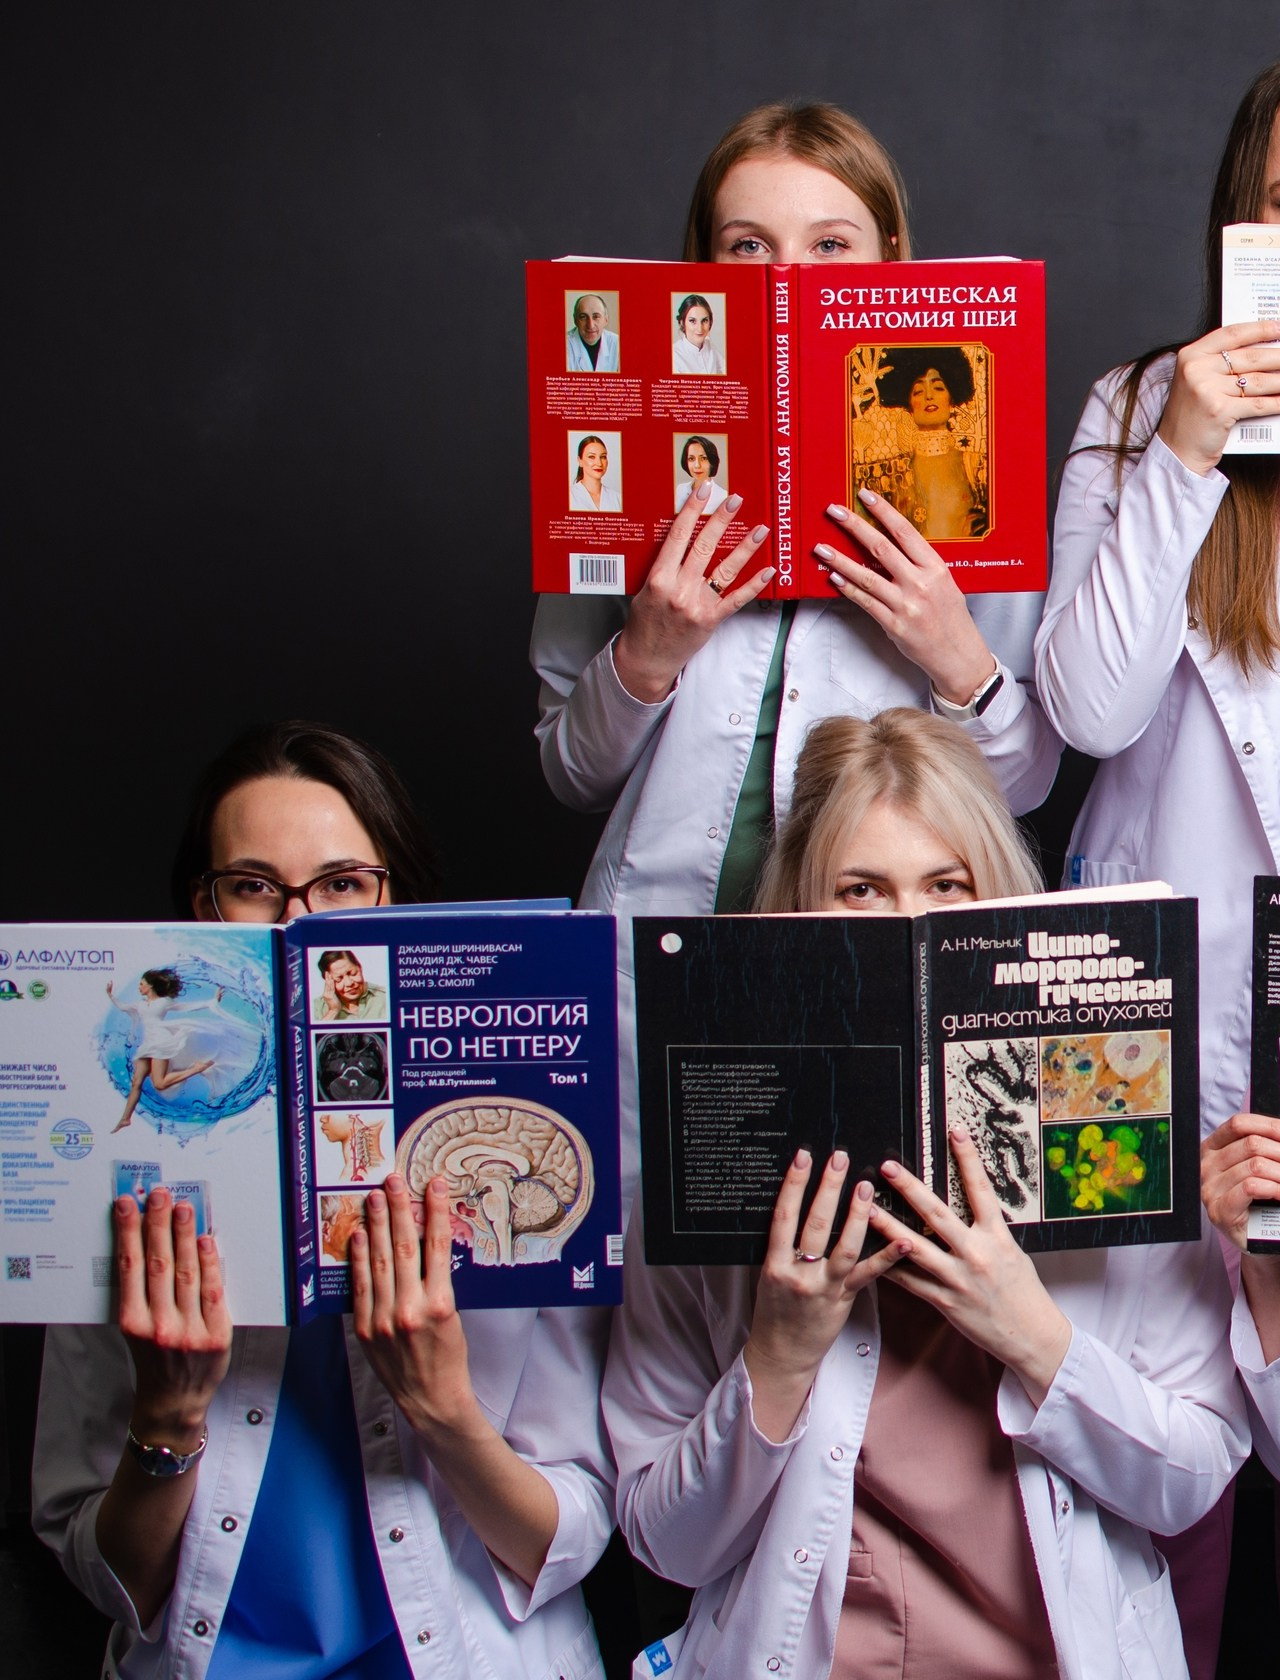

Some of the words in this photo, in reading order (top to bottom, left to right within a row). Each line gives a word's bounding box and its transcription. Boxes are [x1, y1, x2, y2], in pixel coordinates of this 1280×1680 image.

[776, 282, 788, 323] ШЕИ
[820, 286, 1016, 305] ЭСТЕТИЧЕСКАЯ
[820, 311, 954, 328] АНАТОМИЯ
[963, 310, 1016, 326] ШЕИ
[776, 334, 789, 436] АНАТОМИЯ
[776, 446, 791, 585] ЭСТЕТИЧЕСКАЯ
[398, 945, 449, 954] ДЖАЯШРИ
[452, 944, 522, 952] ШРИНИВАСАН
[971, 937, 1022, 950] Мельник
[1028, 931, 1120, 958] Цито-
[15, 949, 113, 966] АЛФЛУТОП
[399, 956, 444, 965] КЛАУДИЯ
[446, 956, 464, 965] ДЖ.
[466, 955, 497, 963] ЧАВЕС
[919, 942, 928, 994] опухолей
[399, 967, 438, 976] БРАЙАН
[440, 967, 458, 976] ДЖ.
[460, 967, 492, 975] СКОТТ
[994, 958, 1144, 985] морфоло-
[438, 978, 474, 987] СМОЛЛ
[1039, 979, 1172, 1006] гическая
[400, 1004, 587, 1027] НЕВРОЛОГИЯ
[942, 1007, 1071, 1036] диагностика
[1077, 1002, 1172, 1027] опухолей
[920, 995, 930, 1068] диагностика
[410, 1037, 452, 1058] ПО
[461, 1035, 580, 1057] НЕТТЕРУ
[294, 1026, 303, 1090] НЕТТЕРУ
[403, 1079, 426, 1087] проф.
[420, 1068, 466, 1077] редакцией
[549, 1072, 577, 1083] Том
[297, 1093, 304, 1118] ПО
[66, 1133, 80, 1145] 25
[120, 1164, 158, 1172] АЛФЛУТОП
[298, 1120, 308, 1222] НЕВРОЛОГИЯ
[300, 1246, 309, 1256] Том
